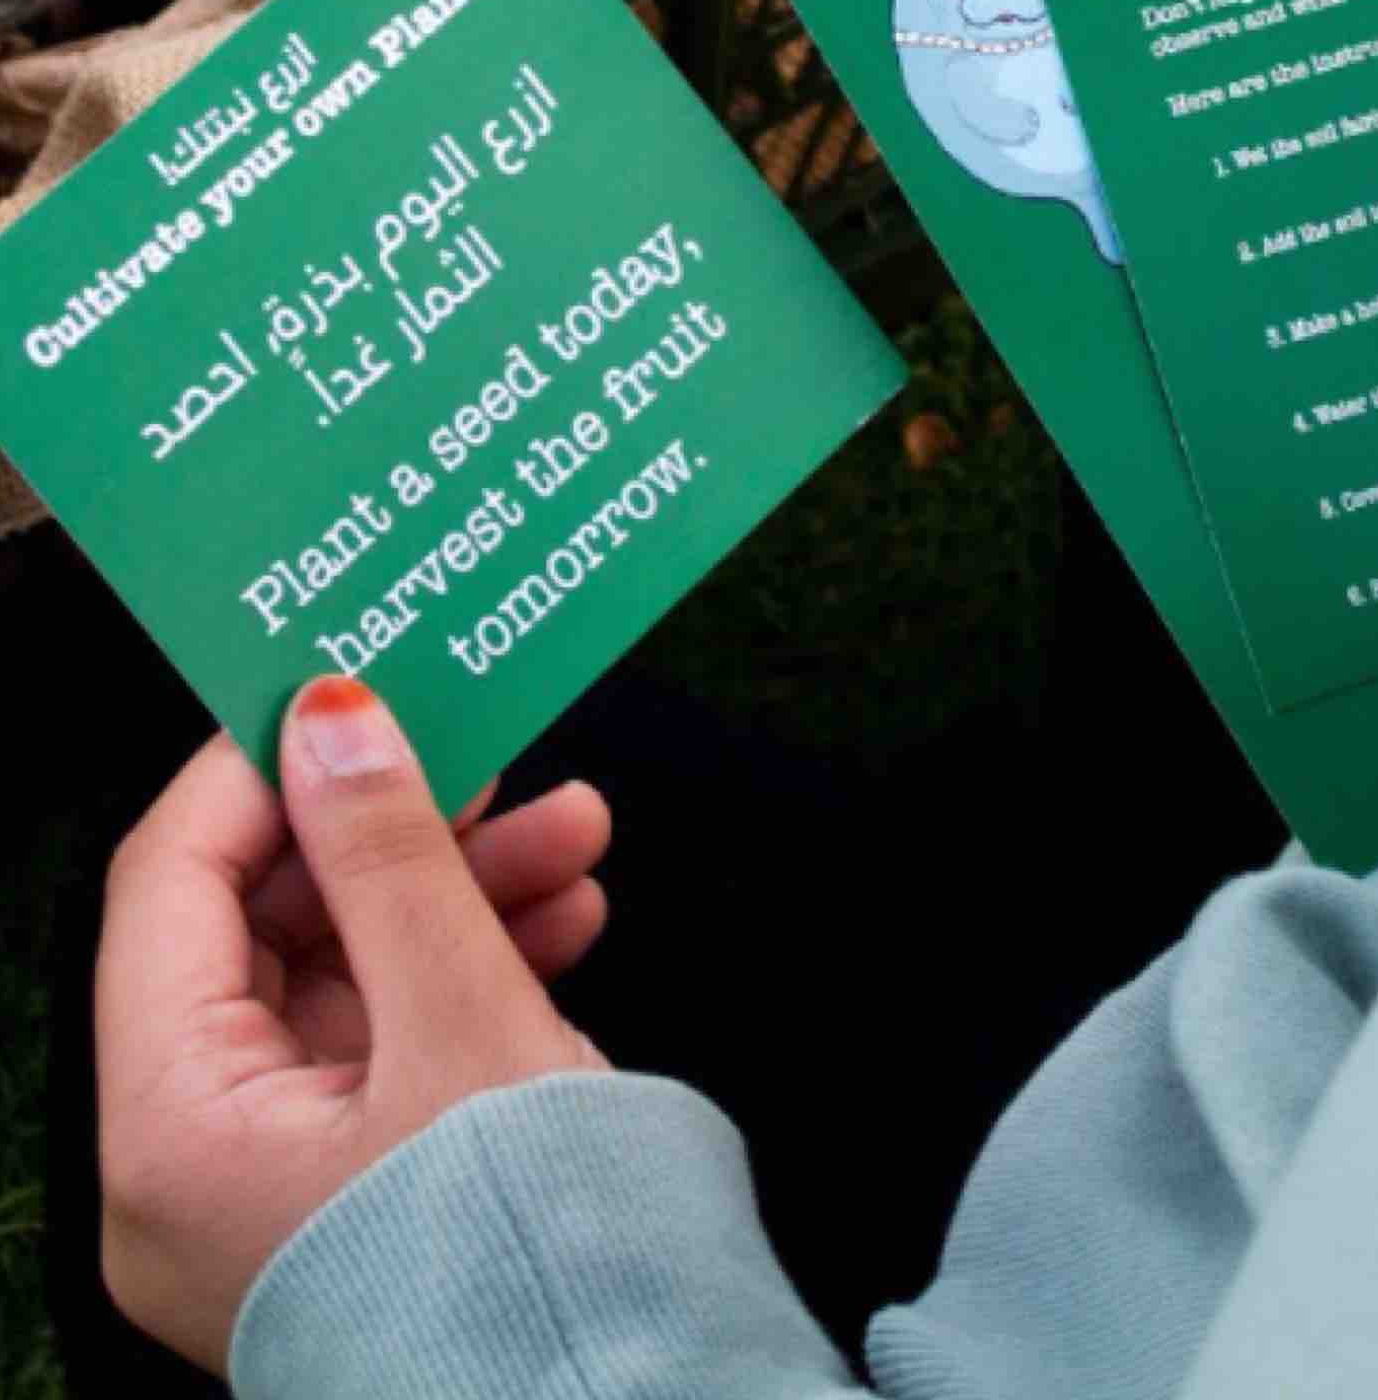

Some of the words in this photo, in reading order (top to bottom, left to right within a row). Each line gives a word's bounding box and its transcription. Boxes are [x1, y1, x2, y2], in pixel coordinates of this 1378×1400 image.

[1150, 17, 1241, 57] observe
[1240, 0, 1287, 30] and
[1165, 86, 1226, 117] Here
[1228, 74, 1268, 98] are
[1268, 61, 1310, 86] the
[23, 207, 206, 367] Cultivate
[198, 127, 294, 227] your
[292, 59, 380, 136] own
[238, 494, 393, 636] Plant
[388, 463, 435, 507] a
[428, 343, 551, 472] seed
[537, 222, 703, 361] today,
[314, 487, 525, 677] harvest
[514, 410, 610, 498] the
[602, 301, 727, 423] fruit
[447, 437, 709, 675] tomorrow.
